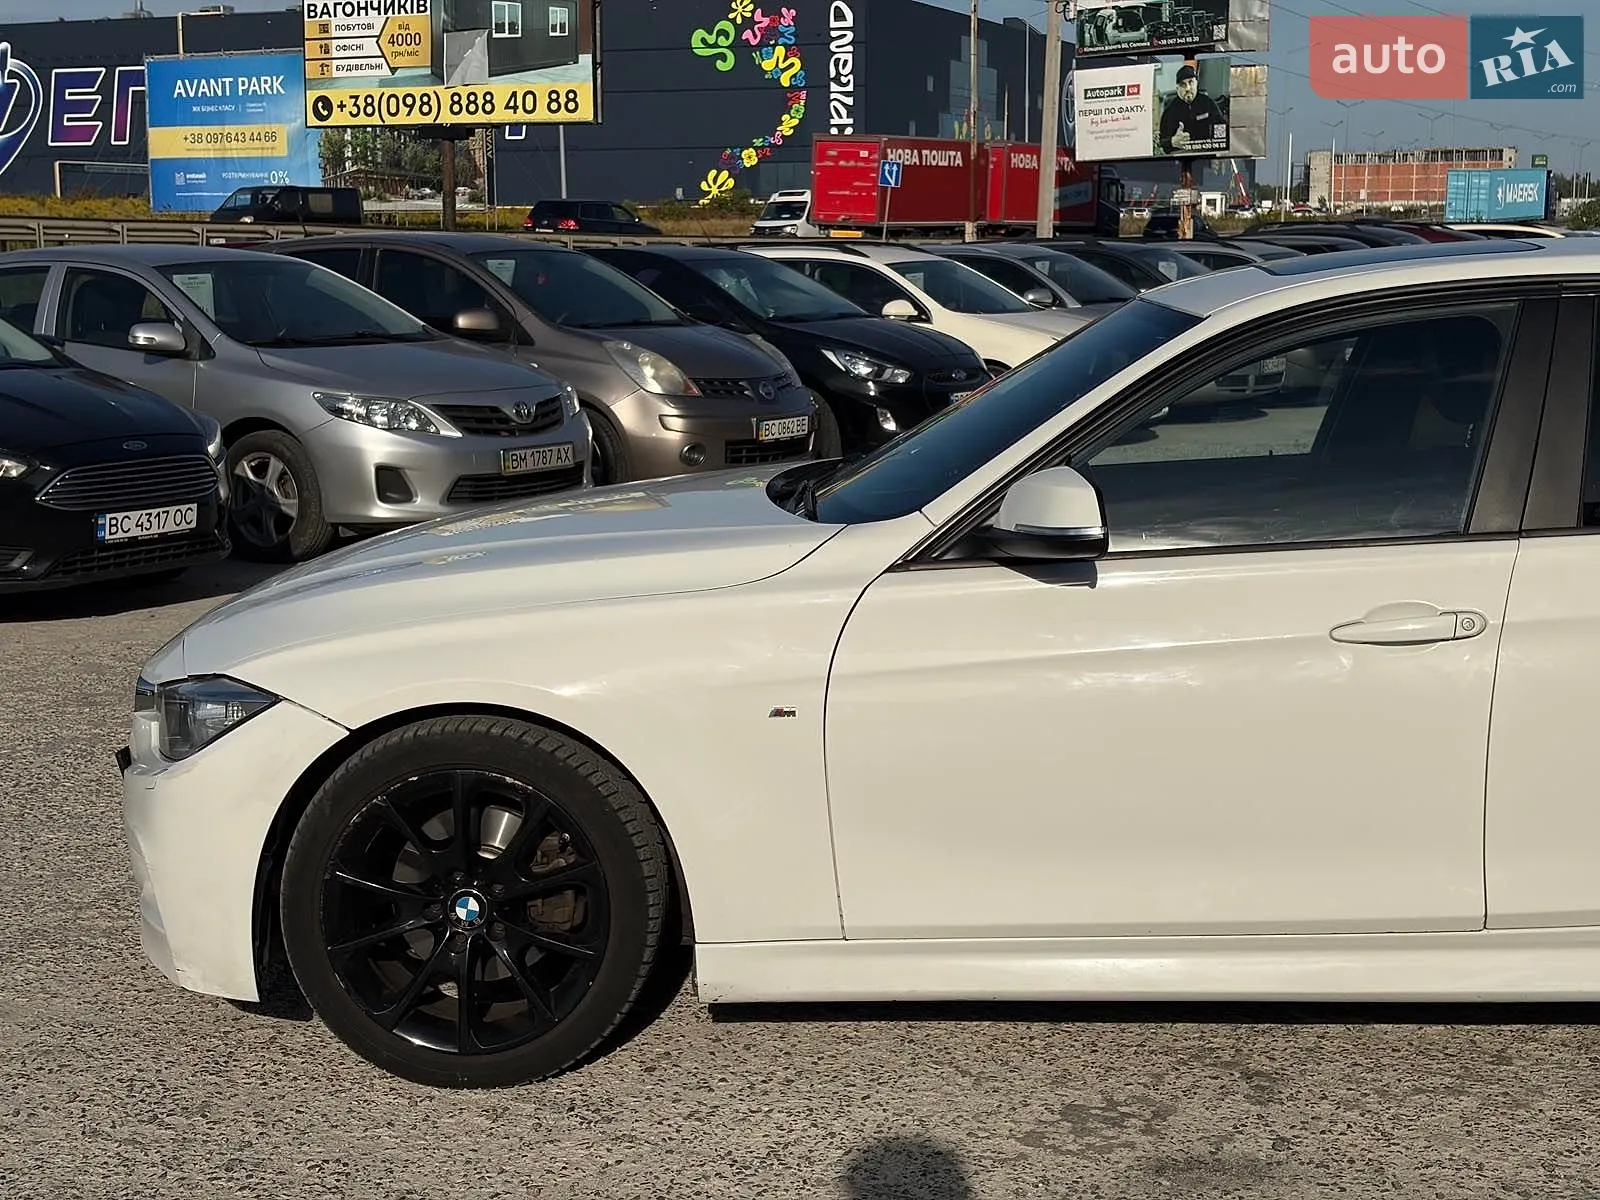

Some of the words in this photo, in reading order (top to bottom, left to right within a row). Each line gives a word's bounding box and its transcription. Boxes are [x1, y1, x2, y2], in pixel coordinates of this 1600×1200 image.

[306, 0, 428, 19] ВАГОНЧИКІВ
[334, 22, 375, 33] ПОБУТОВІ
[397, 21, 410, 31] від
[387, 32, 422, 47] 4000
[335, 43, 364, 53] ОФІСНІ
[390, 47, 419, 60] грн/міс
[335, 63, 384, 73] БУДІВЕЛЬНІ
[173, 77, 234, 98] AVANT
[238, 75, 286, 95] PARK
[1086, 87, 1123, 99] Autopark
[337, 90, 441, 123] +38(098)
[449, 90, 496, 116] 888
[504, 90, 537, 115] 40
[546, 89, 579, 114] 88
[1078, 108, 1103, 117] ПЕРШІ
[1104, 107, 1116, 115] ПО
[1117, 105, 1147, 114] ФАКТУ.
[183, 133, 203, 144] +38
[205, 132, 224, 144] 097
[225, 132, 246, 143] 643
[249, 132, 262, 142] 44
[264, 131, 277, 142] 66
[887, 148, 919, 168] НОВА
[922, 148, 963, 168] ПОШТА
[1010, 152, 1039, 170] НОВА
[270, 170, 290, 185] 0%
[1506, 181, 1540, 204] MAERSK
[764, 422, 777, 438] BC
[777, 419, 796, 436] 0862
[796, 417, 807, 433] BE
[510, 452, 528, 470] BM
[530, 448, 553, 468] 1787
[556, 446, 571, 464] AX
[108, 516, 131, 536] BC
[135, 509, 170, 533] 4317
[173, 506, 194, 527] OC
